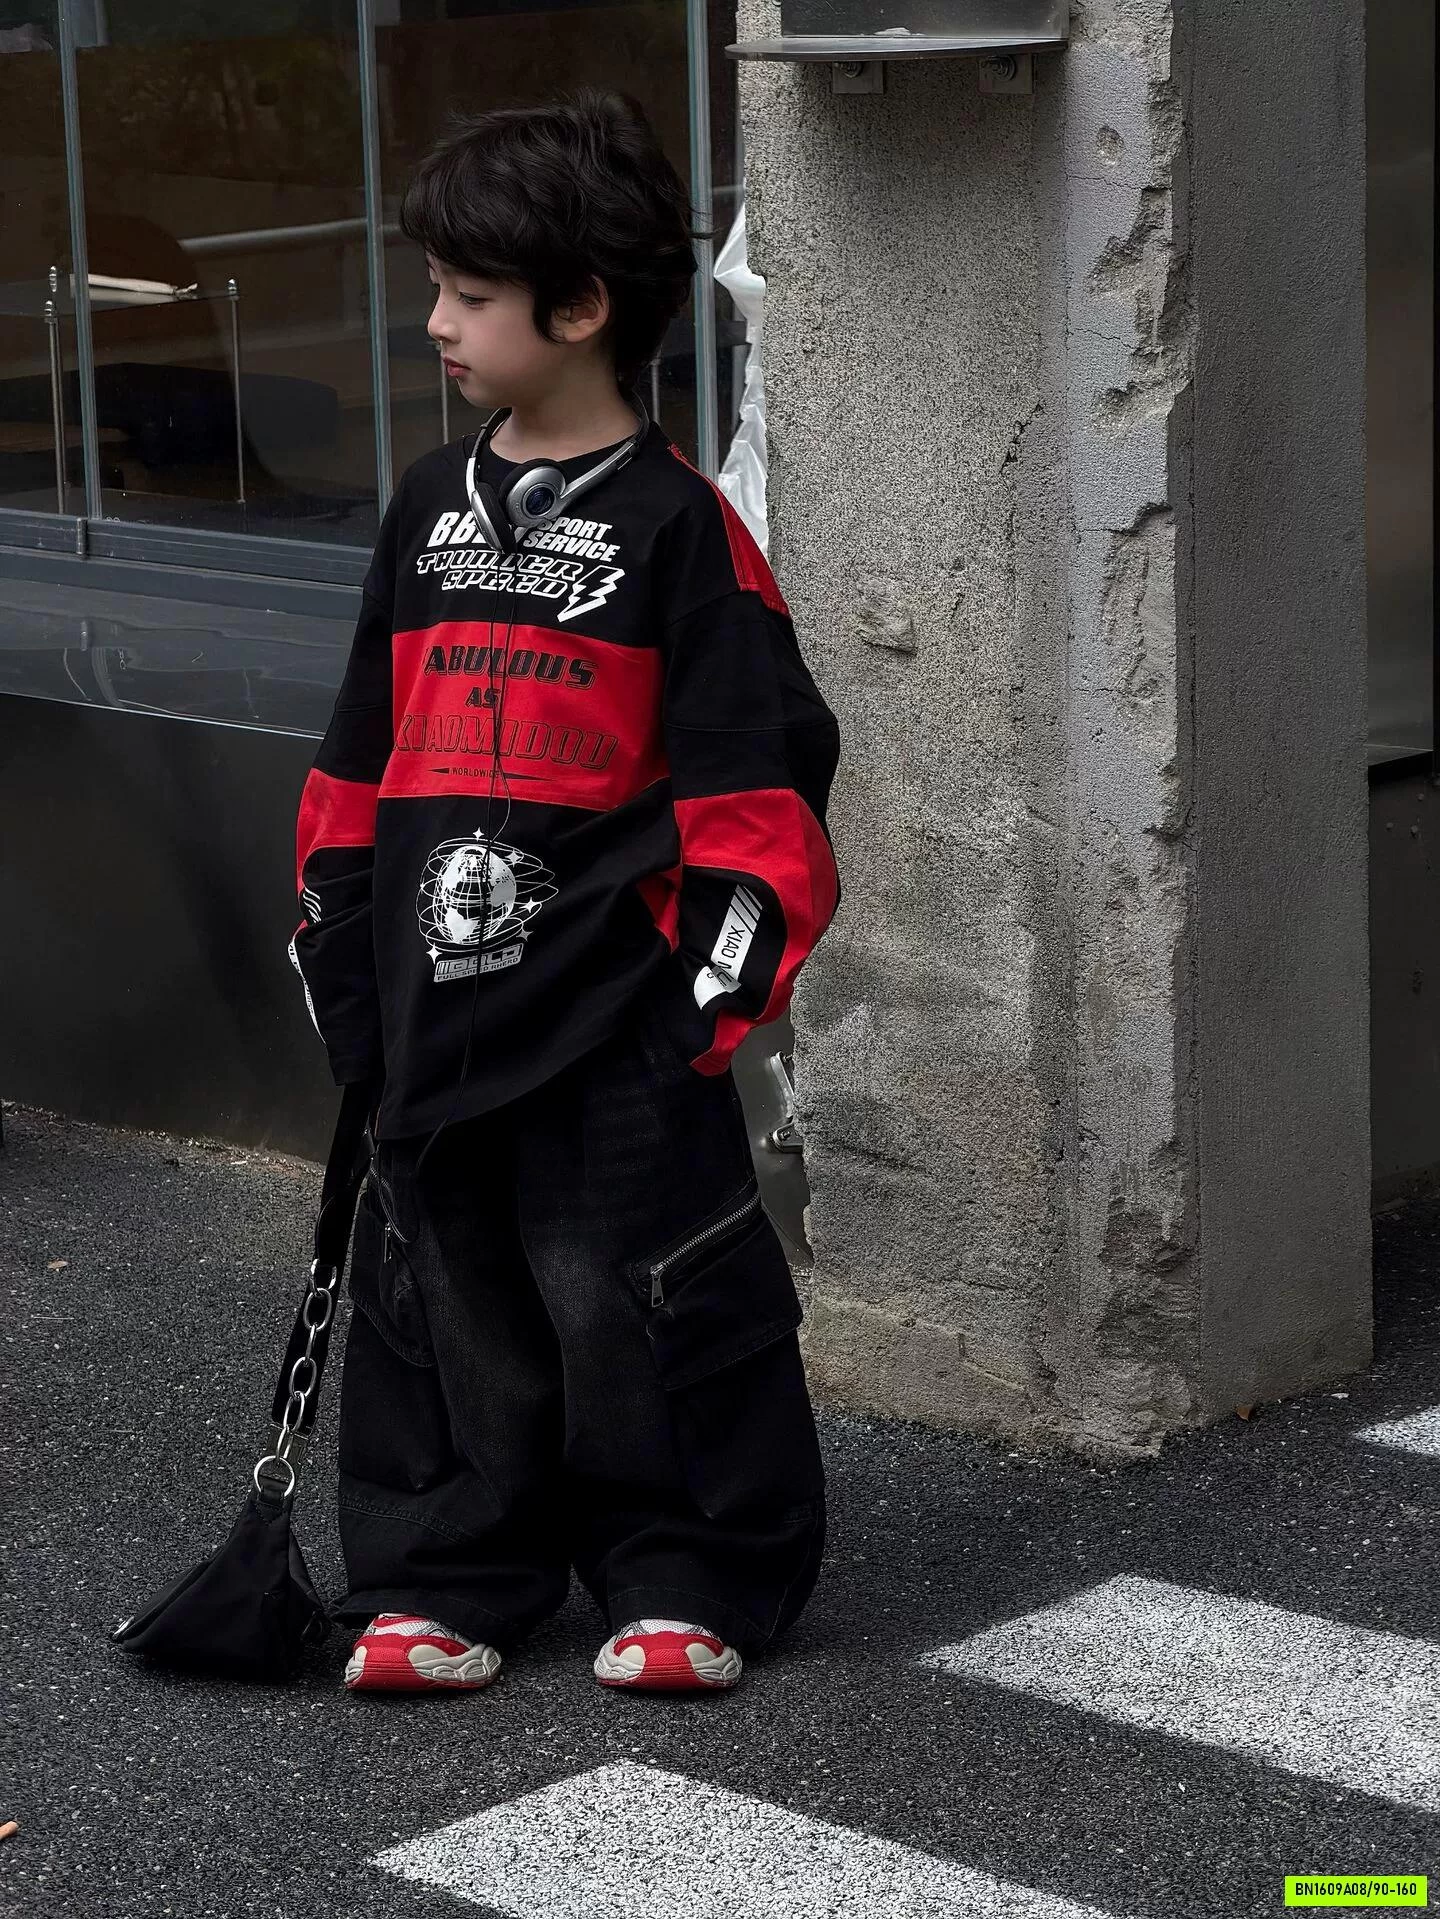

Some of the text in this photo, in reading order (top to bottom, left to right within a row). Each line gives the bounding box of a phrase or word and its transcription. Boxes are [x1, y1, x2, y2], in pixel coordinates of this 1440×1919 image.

[537, 516, 613, 542] SPORT
[523, 530, 621, 563] SERVICE
[416, 549, 584, 582] THUNDER
[441, 570, 568, 599] SPEED
[465, 687, 501, 708] AS
[452, 767, 499, 779] WORLDWIDE
[720, 924, 746, 960] XIAO
[463, 965, 488, 976] SPED
